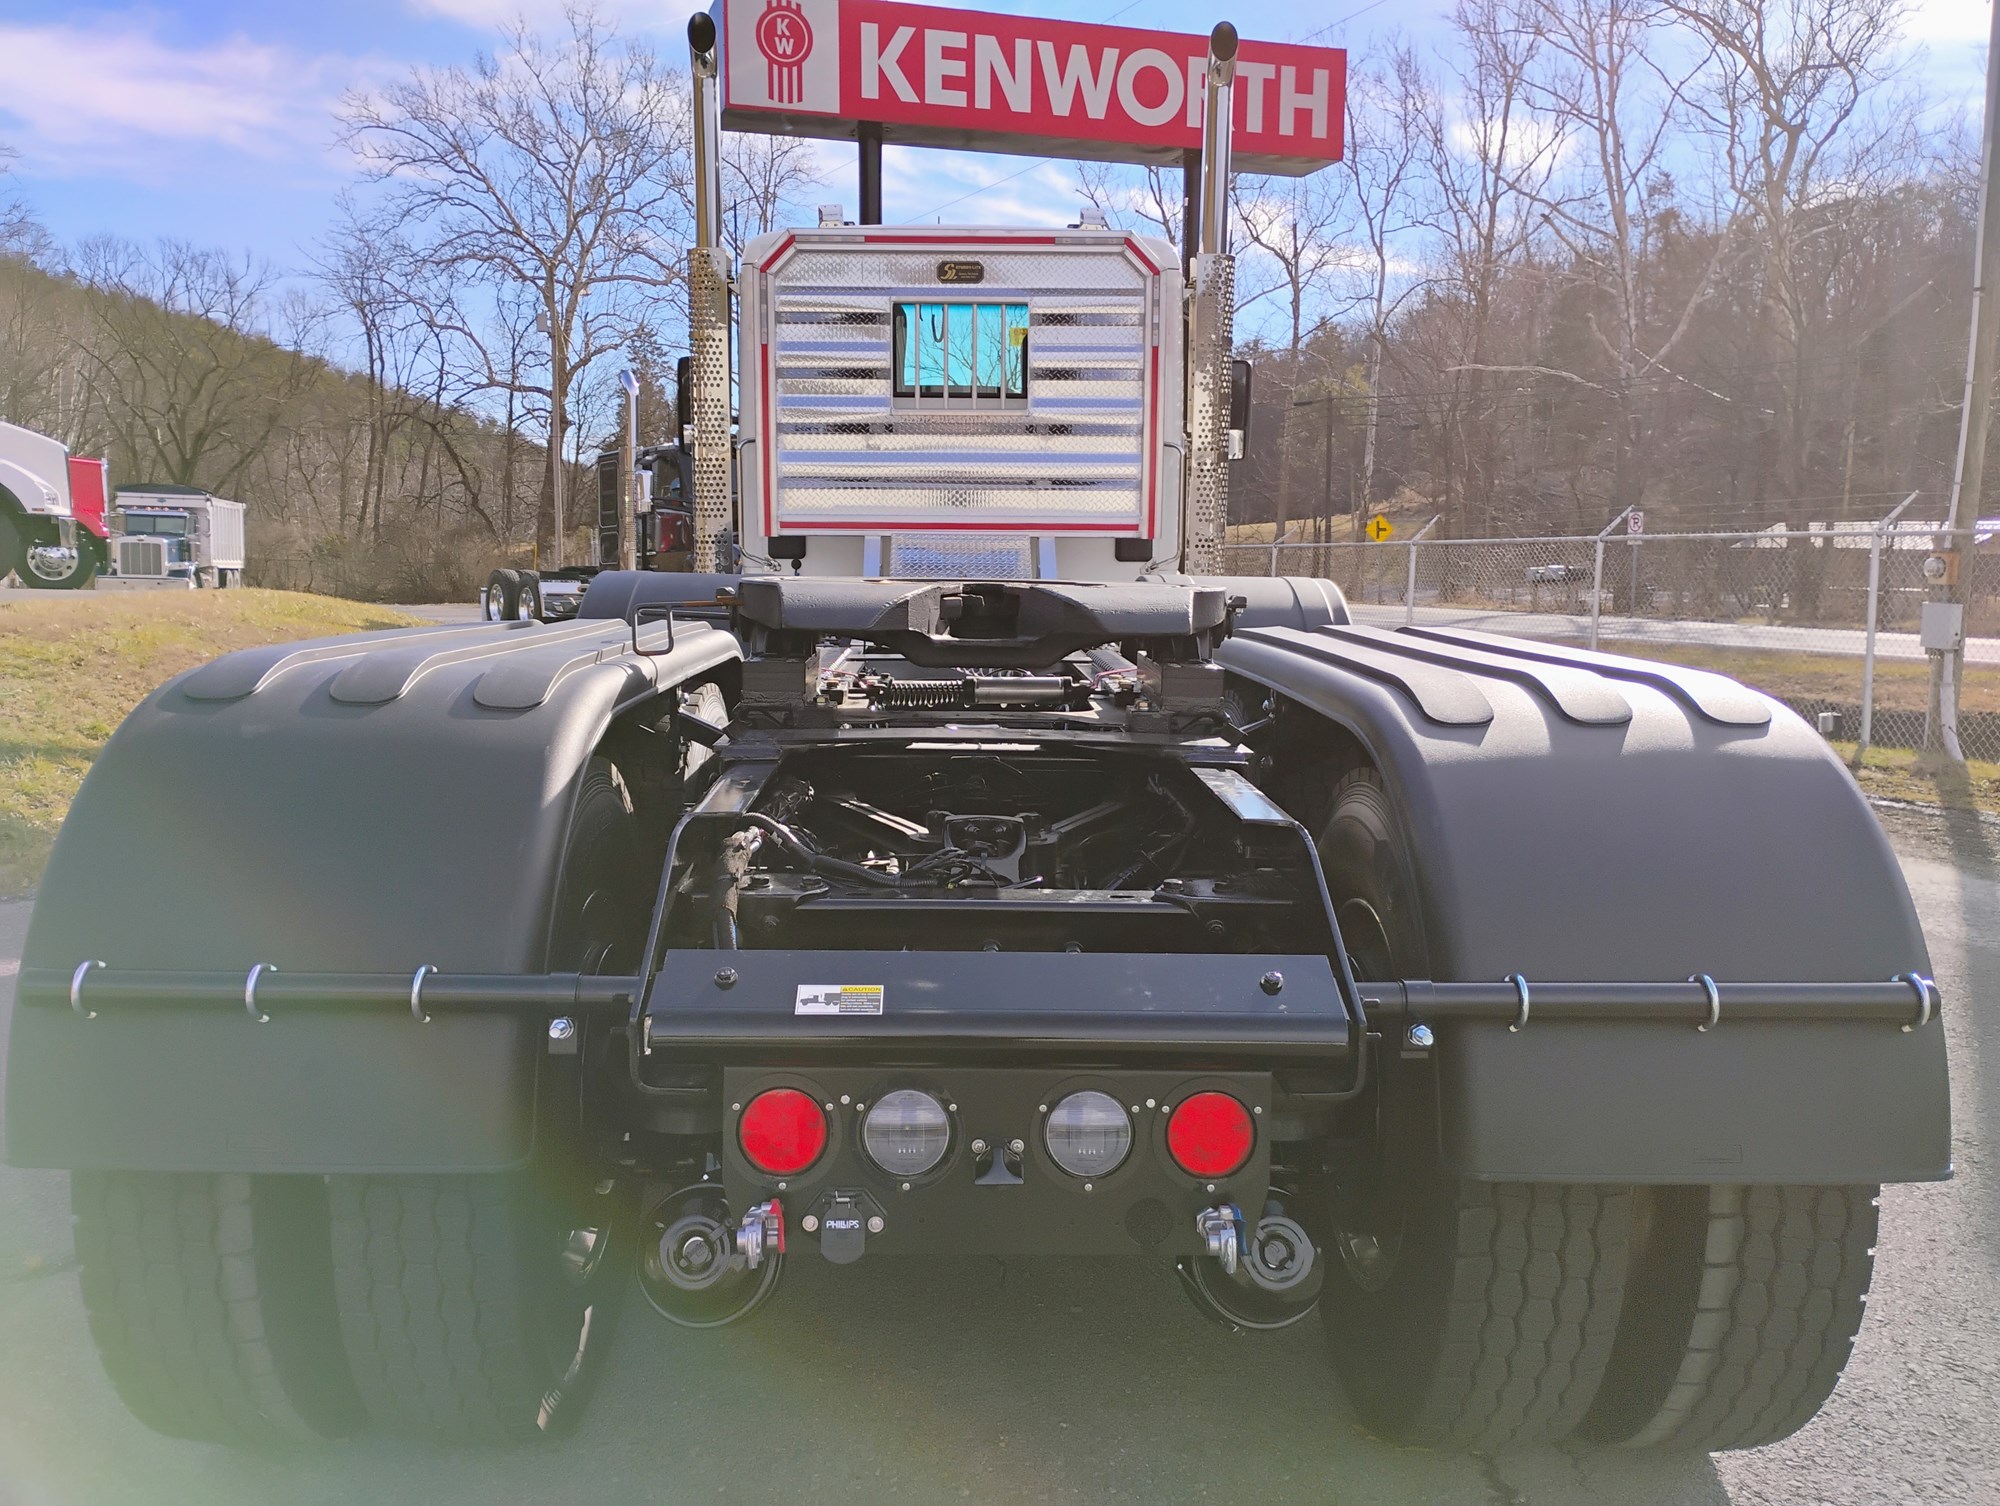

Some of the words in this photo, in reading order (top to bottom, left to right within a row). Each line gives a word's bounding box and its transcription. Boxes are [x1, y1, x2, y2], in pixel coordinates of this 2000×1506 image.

[776, 17, 790, 36] K
[774, 36, 795, 56] W
[826, 1220, 860, 1229] PHILLIPS
